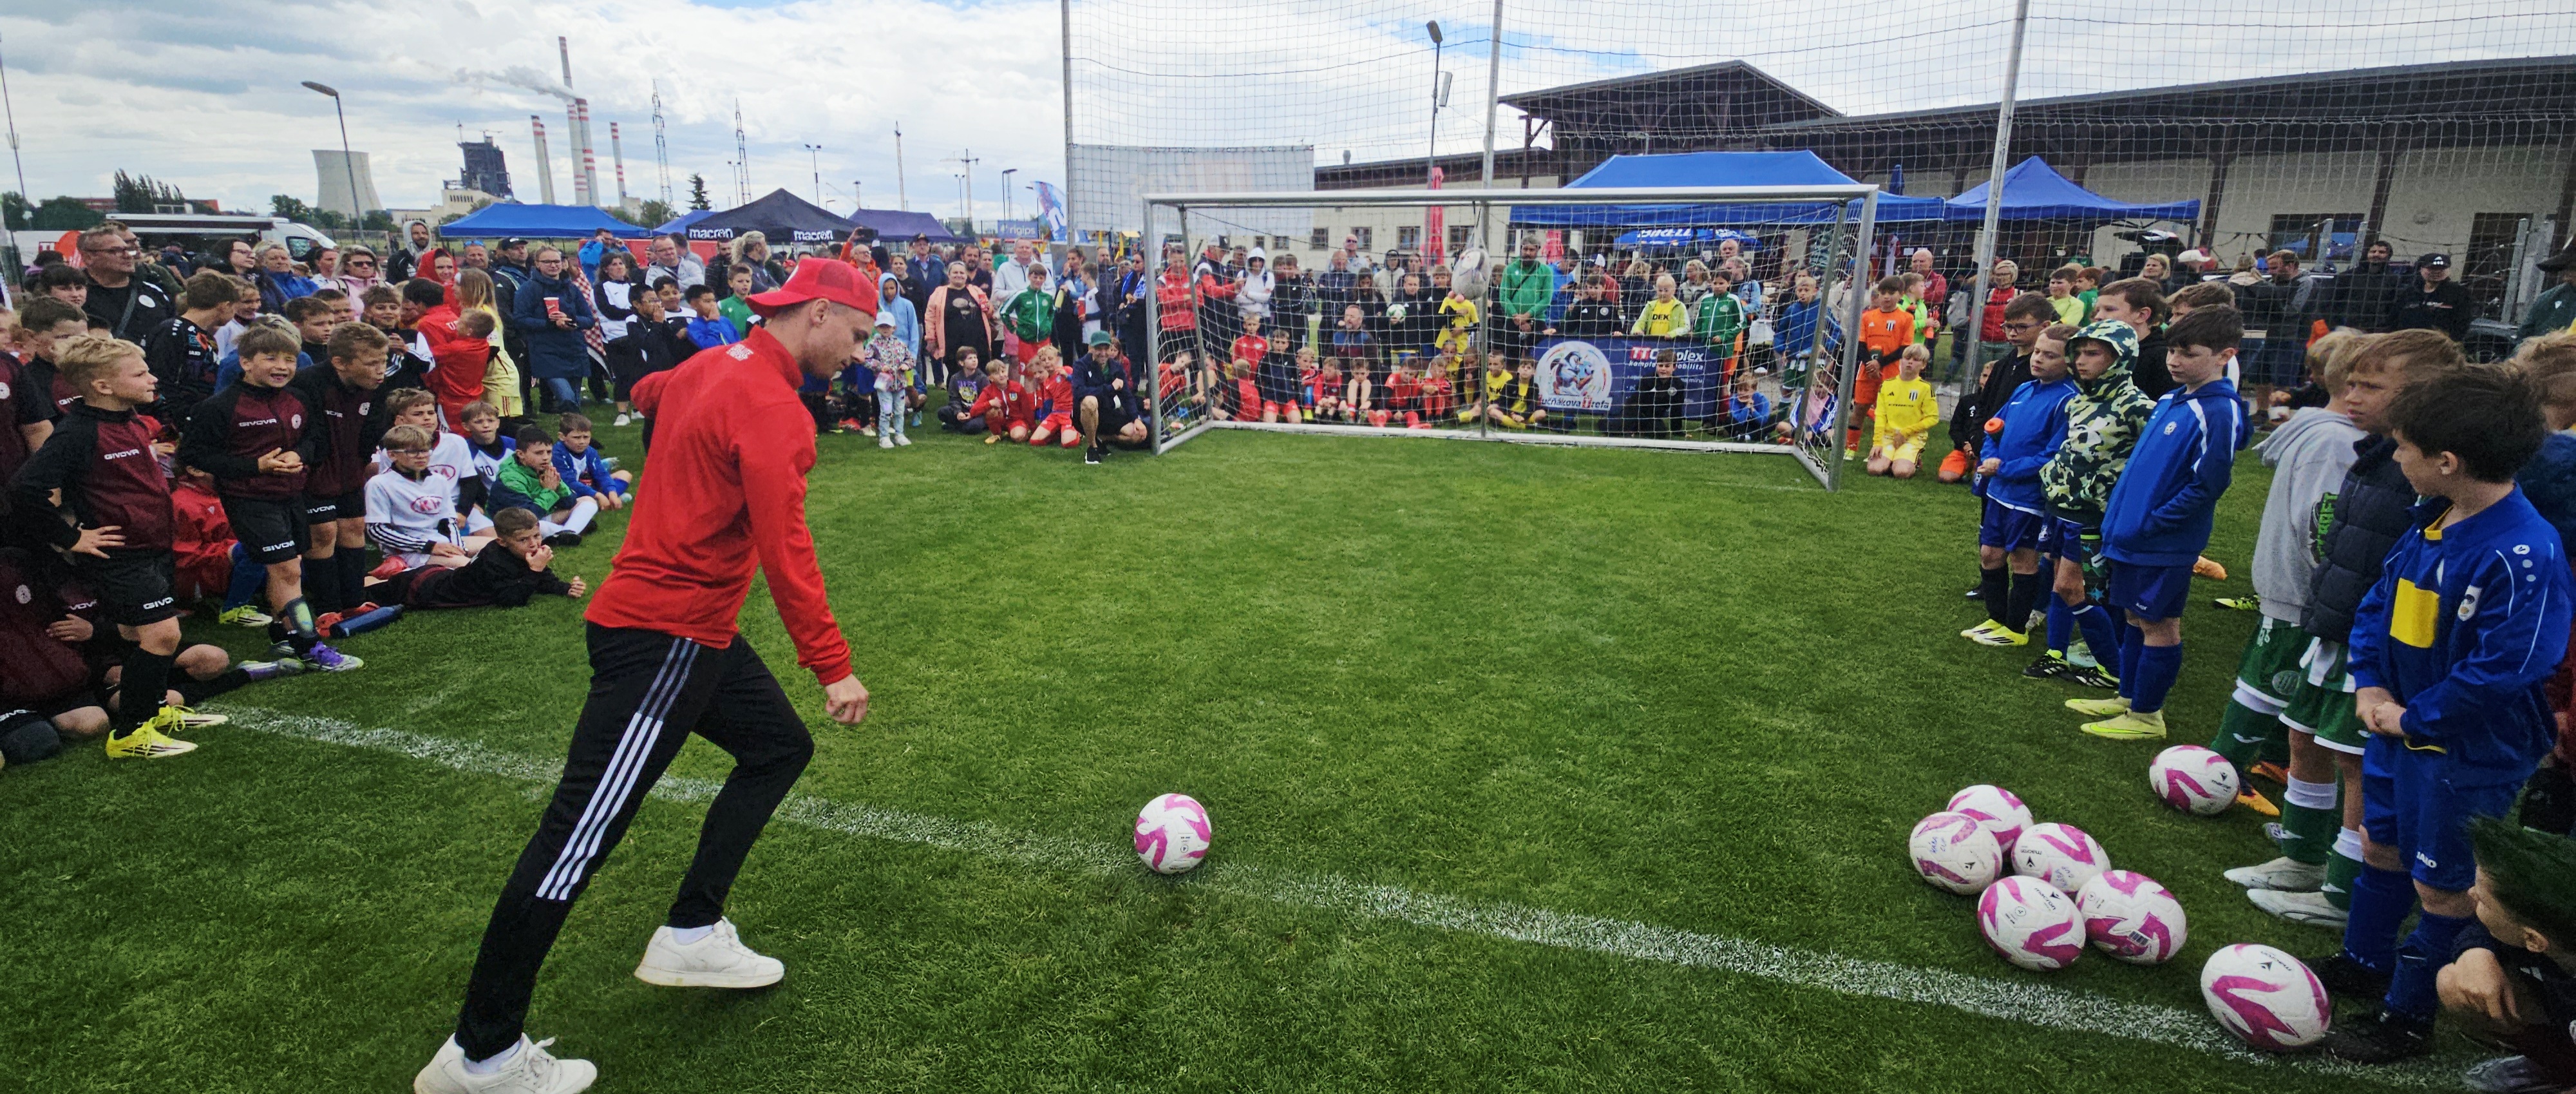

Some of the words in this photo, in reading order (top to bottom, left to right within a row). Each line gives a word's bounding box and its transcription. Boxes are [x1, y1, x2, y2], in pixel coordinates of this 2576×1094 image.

[689, 228, 733, 239] macron
[793, 230, 833, 241] macron
[1632, 346, 1704, 361] TTCplex
[239, 418, 277, 427] GIVOVA
[104, 449, 140, 460] GIVOVA
[143, 597, 174, 609] GIVO
